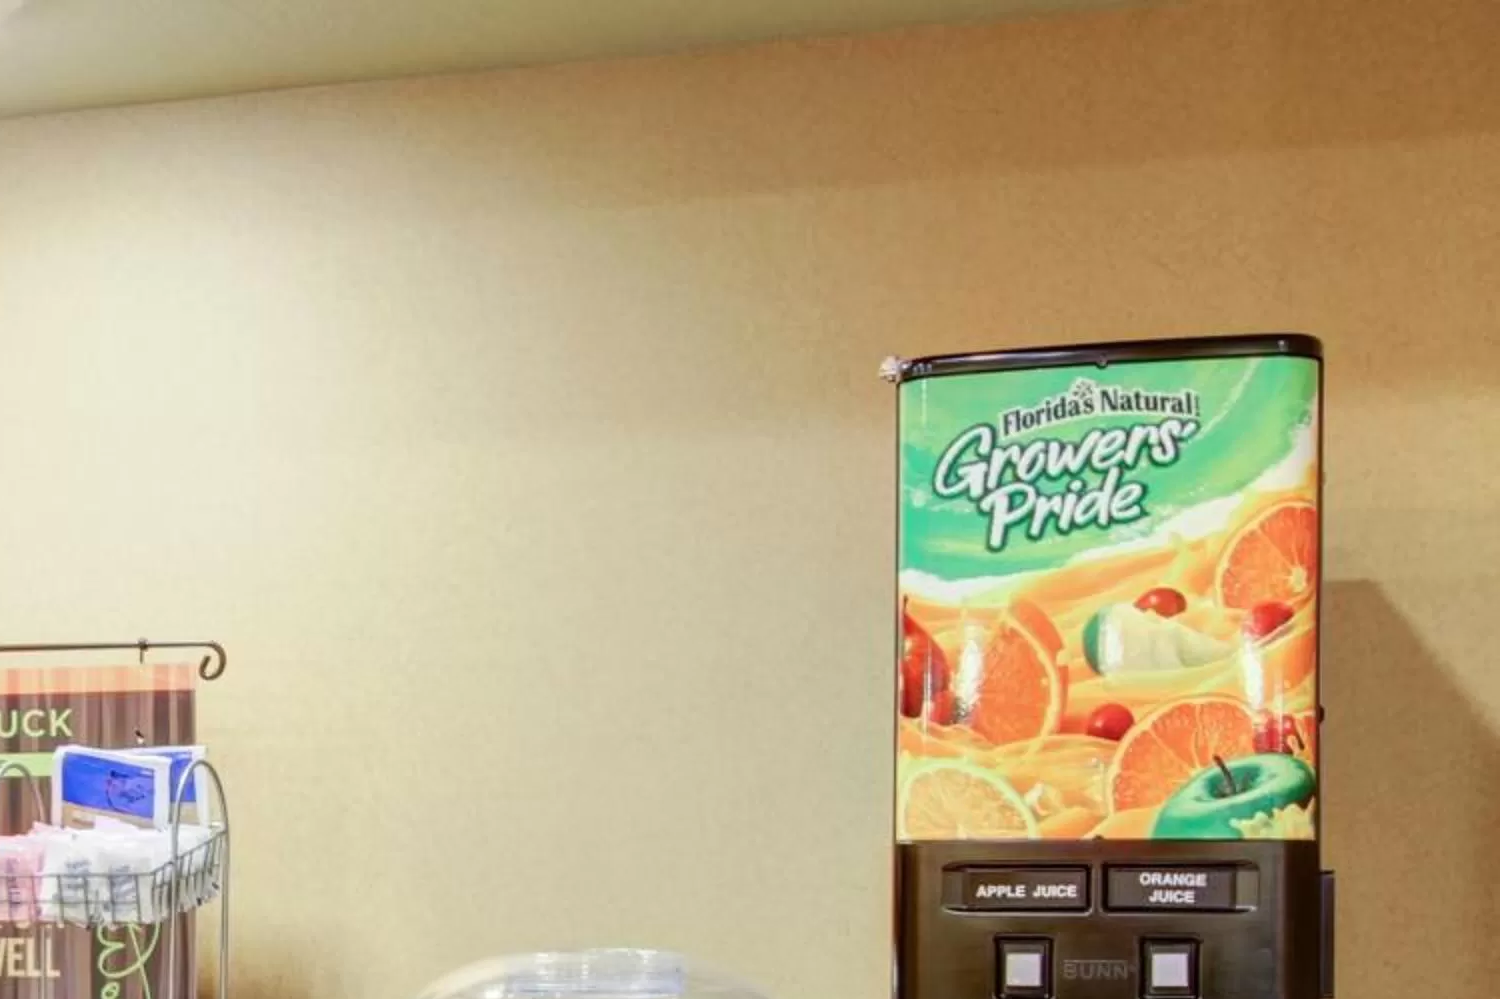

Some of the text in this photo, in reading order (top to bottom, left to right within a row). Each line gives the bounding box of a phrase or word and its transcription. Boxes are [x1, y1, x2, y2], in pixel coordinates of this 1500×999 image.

[980, 467, 1146, 549] Pride
[1139, 873, 1208, 887] ORANGE
[975, 884, 1077, 898] APPLE JUICE
[1148, 890, 1196, 903] JUICE
[1063, 959, 1129, 979] BUNN
